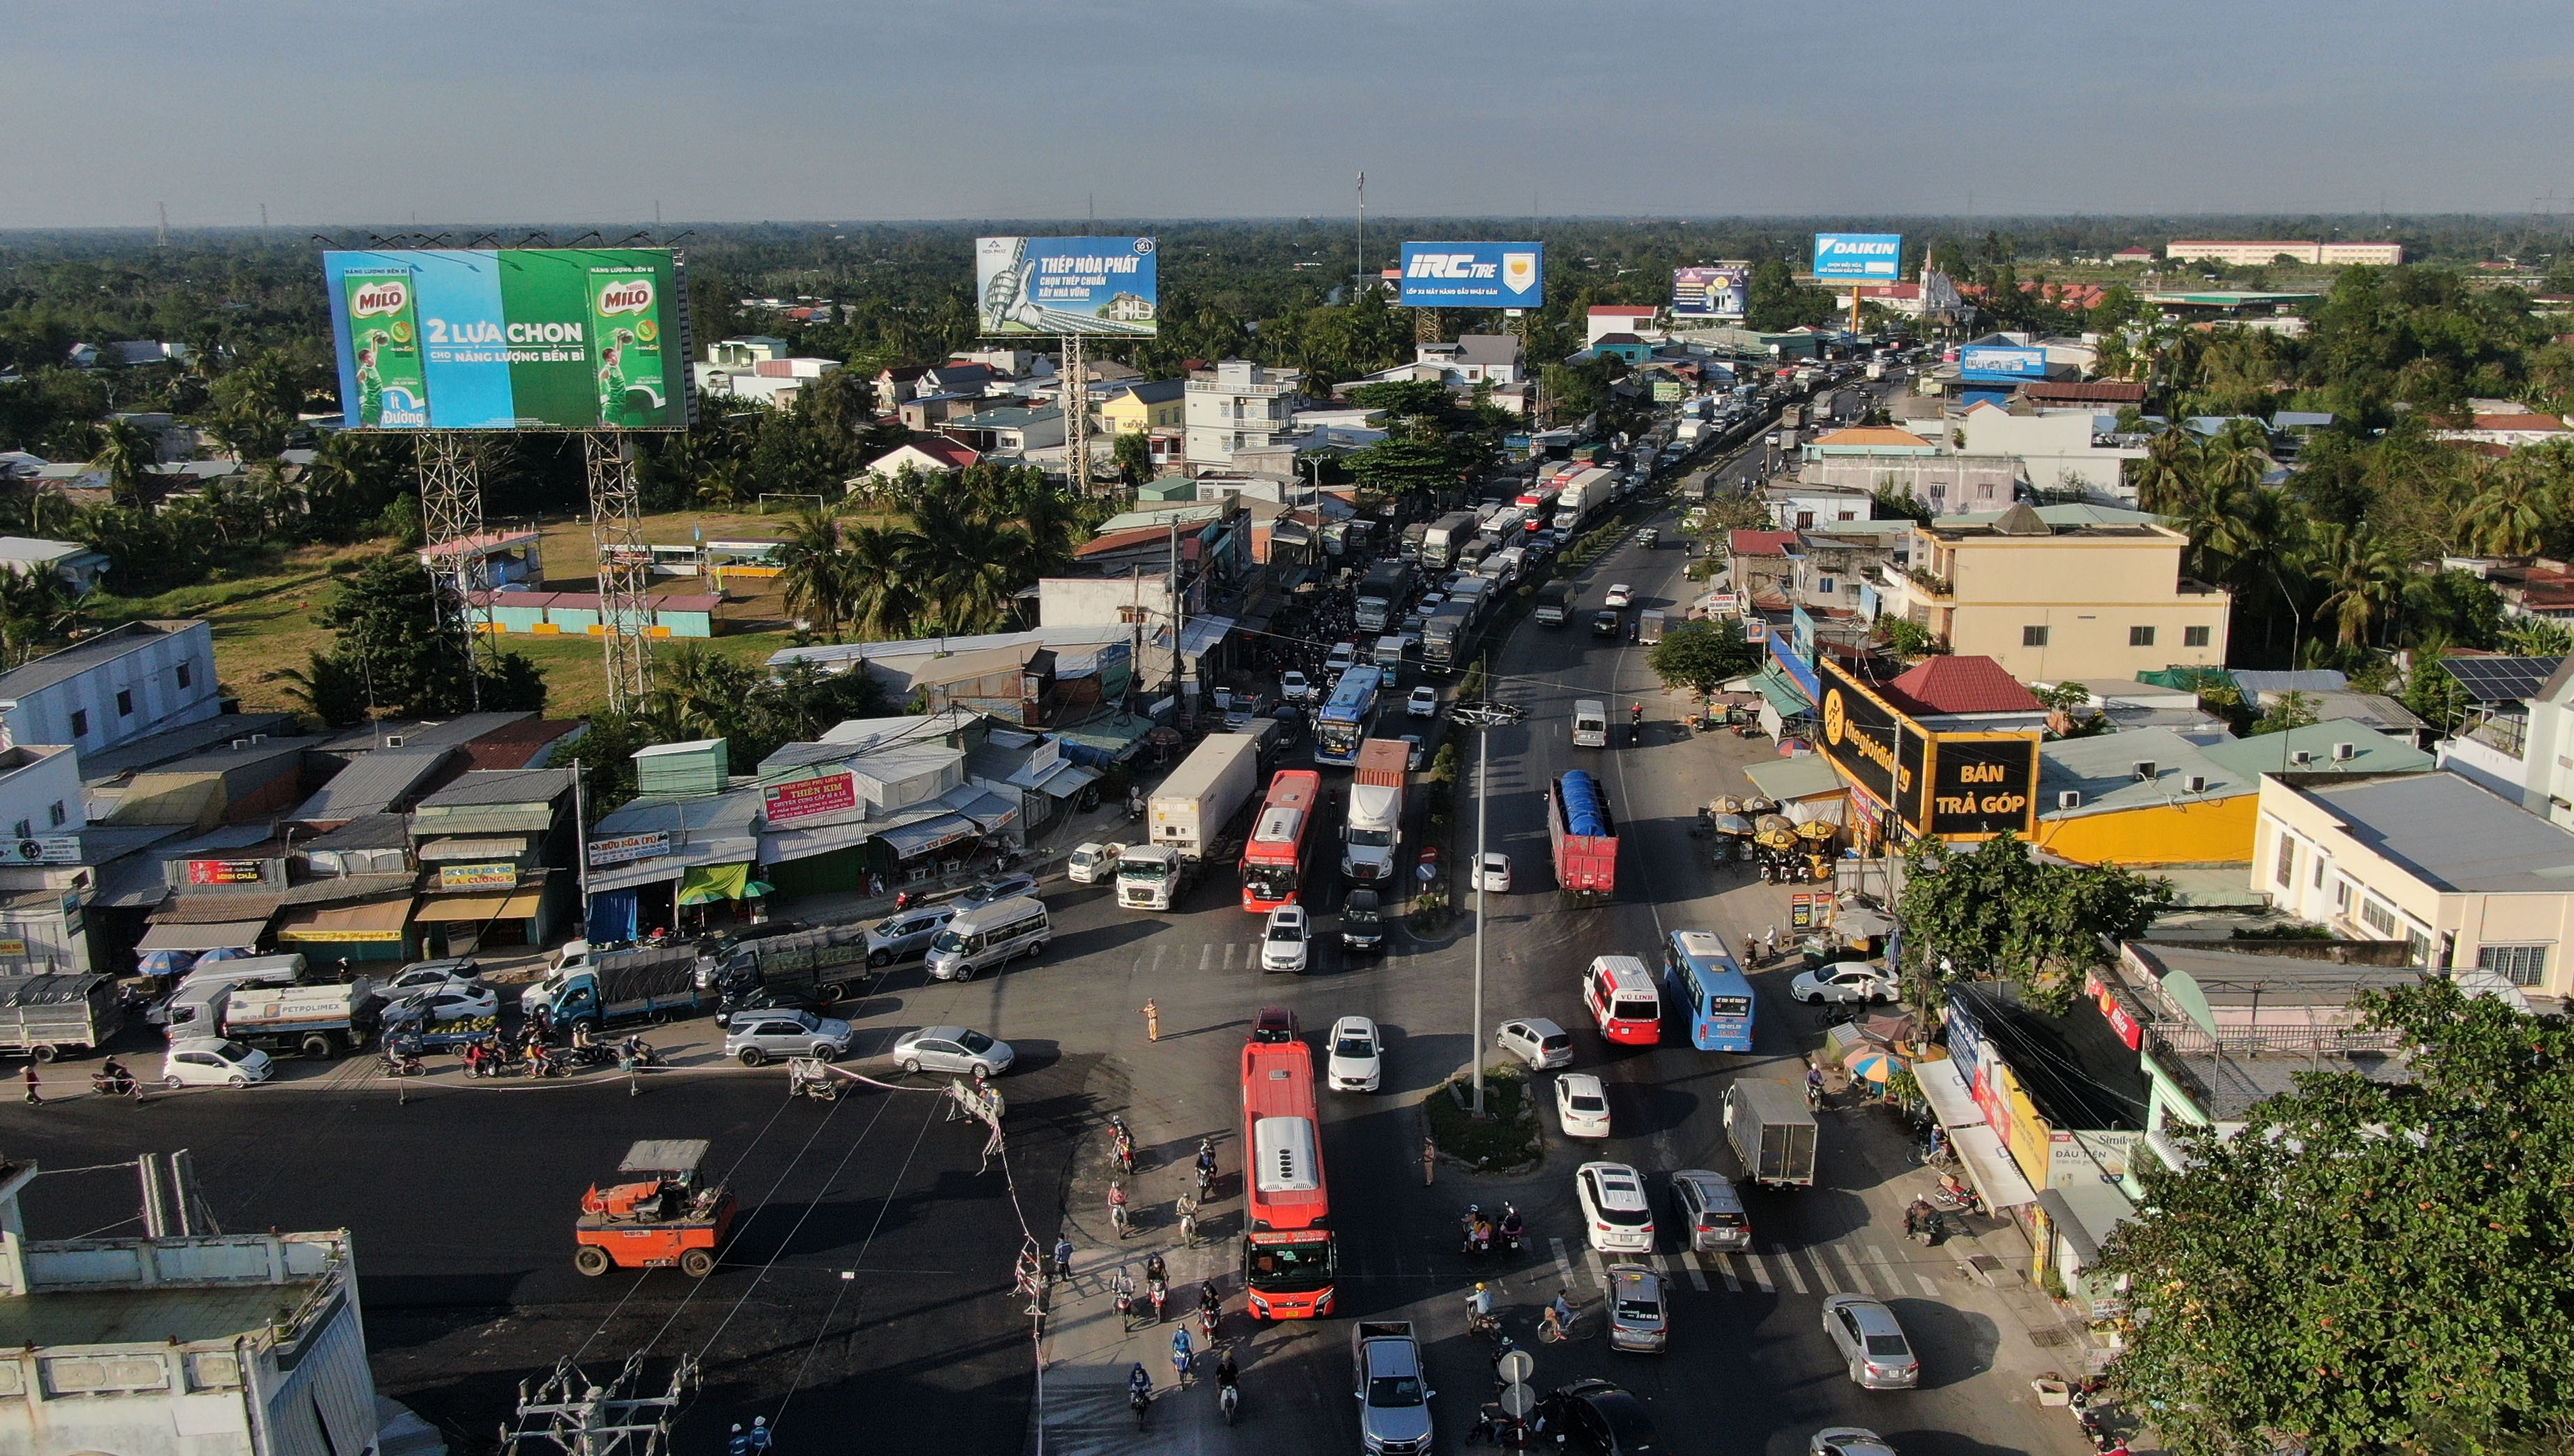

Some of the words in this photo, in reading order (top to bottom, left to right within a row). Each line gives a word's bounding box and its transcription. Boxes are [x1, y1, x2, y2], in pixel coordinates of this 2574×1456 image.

[1834, 243, 1896, 254] DAIKIN
[1041, 255, 1074, 274] THÉP
[1075, 254, 1103, 274] HÒA
[1104, 254, 1140, 273] PHÁT
[1406, 254, 1475, 278] IRC
[1467, 263, 1497, 278] TIRE
[1040, 276, 1060, 287] CHỌN
[1062, 275, 1081, 286] THÉP
[1081, 273, 1106, 286] CHUẨN
[360, 291, 402, 309] MILO
[605, 290, 648, 308] MILO
[1038, 287, 1053, 297] XÂY
[1053, 286, 1069, 297] NHÀ
[1069, 286, 1090, 297] VỮNG
[426, 319, 448, 343] 2
[452, 320, 505, 349] LỰA
[507, 323, 584, 348] CHỌN
[455, 351, 492, 362] NĂNG
[495, 350, 540, 365] LƯỢNG
[542, 348, 569, 362] BỀN
[390, 392, 400, 410] Ít
[383, 409, 424, 427] Đường
[1960, 762, 2004, 783] BÁN
[791, 786, 821, 799] THIÊN
[823, 783, 843, 793] KIM
[1936, 791, 1977, 814] TRẢ
[1981, 791, 2025, 813] GÓP
[282, 1003, 340, 1013] PETROLIMEX
[2099, 1135, 2132, 1145] Simila
